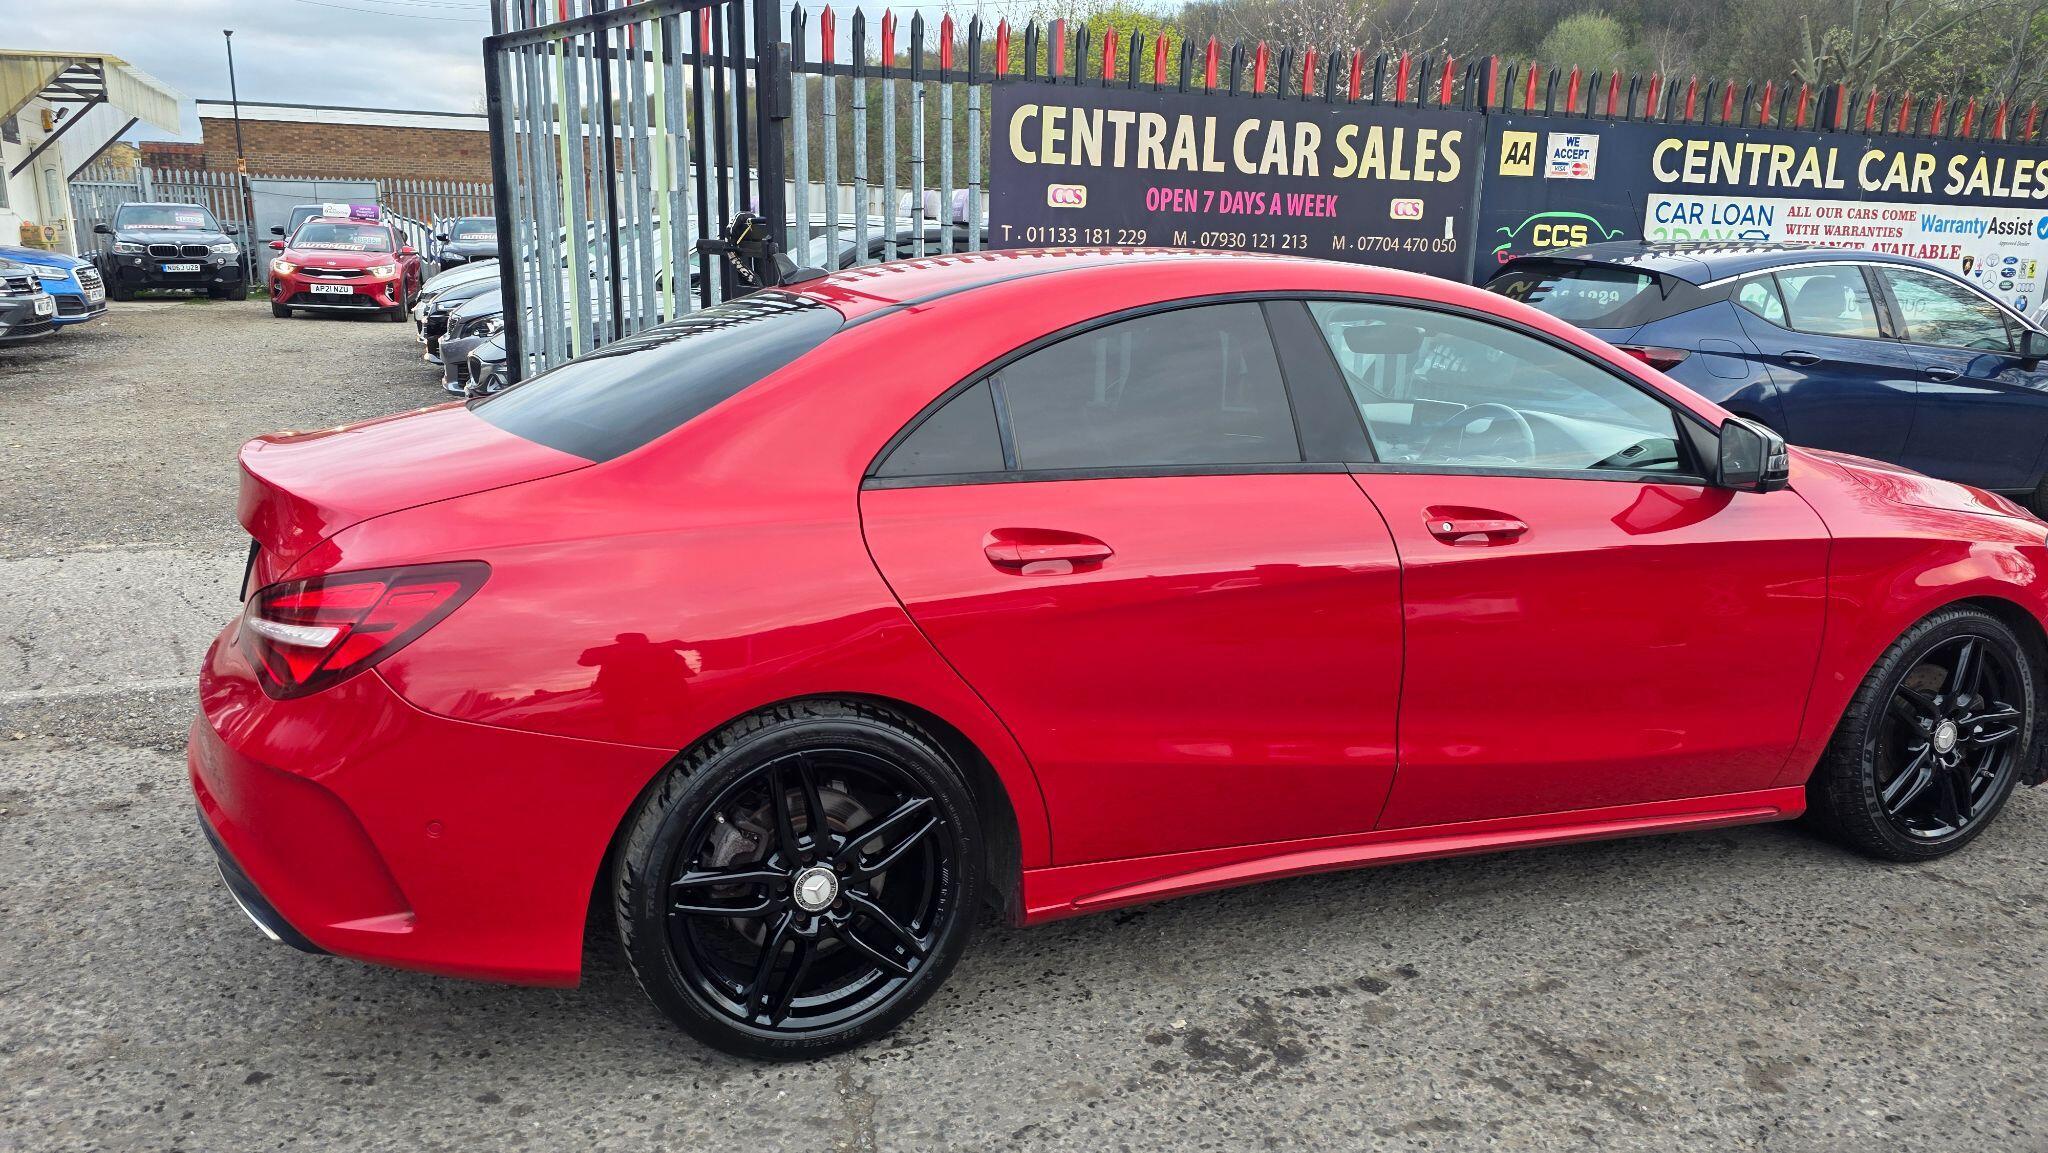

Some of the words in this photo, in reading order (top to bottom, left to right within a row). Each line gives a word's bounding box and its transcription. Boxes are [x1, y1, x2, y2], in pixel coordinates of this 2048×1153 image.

[1009, 103, 1226, 173] CENTRAL
[1233, 118, 1322, 177] CAR
[1332, 124, 1462, 183] SALES
[1565, 136, 1581, 147] WE
[1503, 141, 1532, 165] AA
[1553, 148, 1590, 160] ACCEPT
[1652, 138, 1845, 189] CENTRAL
[1858, 149, 1937, 194] CAR
[1943, 154, 2048, 200] SALES
[1145, 187, 1198, 213] OPEN
[1203, 190, 1215, 213] 7
[1219, 190, 1266, 215] DAYS
[1269, 192, 1282, 216] A
[1286, 193, 1339, 218] WEEK
[1655, 200, 1705, 225] CAR
[1711, 203, 1775, 227] LOAN
[1787, 205, 1812, 218] ALL
[1816, 206, 1843, 219] OUR
[1847, 207, 1879, 220] CARS
[1882, 209, 1917, 222] COME
[1026, 226, 1077, 243] 01133
[1084, 228, 1110, 245] 181
[1117, 229, 1147, 245] 229
[1532, 223, 1588, 248] CCS
[1785, 223, 1821, 236] WITH
[1824, 224, 1904, 238] WARRANTIES
[1200, 231, 1246, 248] 07930
[1252, 233, 1276, 249] 121
[1281, 234, 1308, 250] 213
[1357, 236, 1400, 252] 07704
[1403, 237, 1428, 253] 470
[1432, 238, 1457, 253] 050
[1871, 242, 1962, 260] AVAILABLE
[315, 285, 332, 293] AP21
